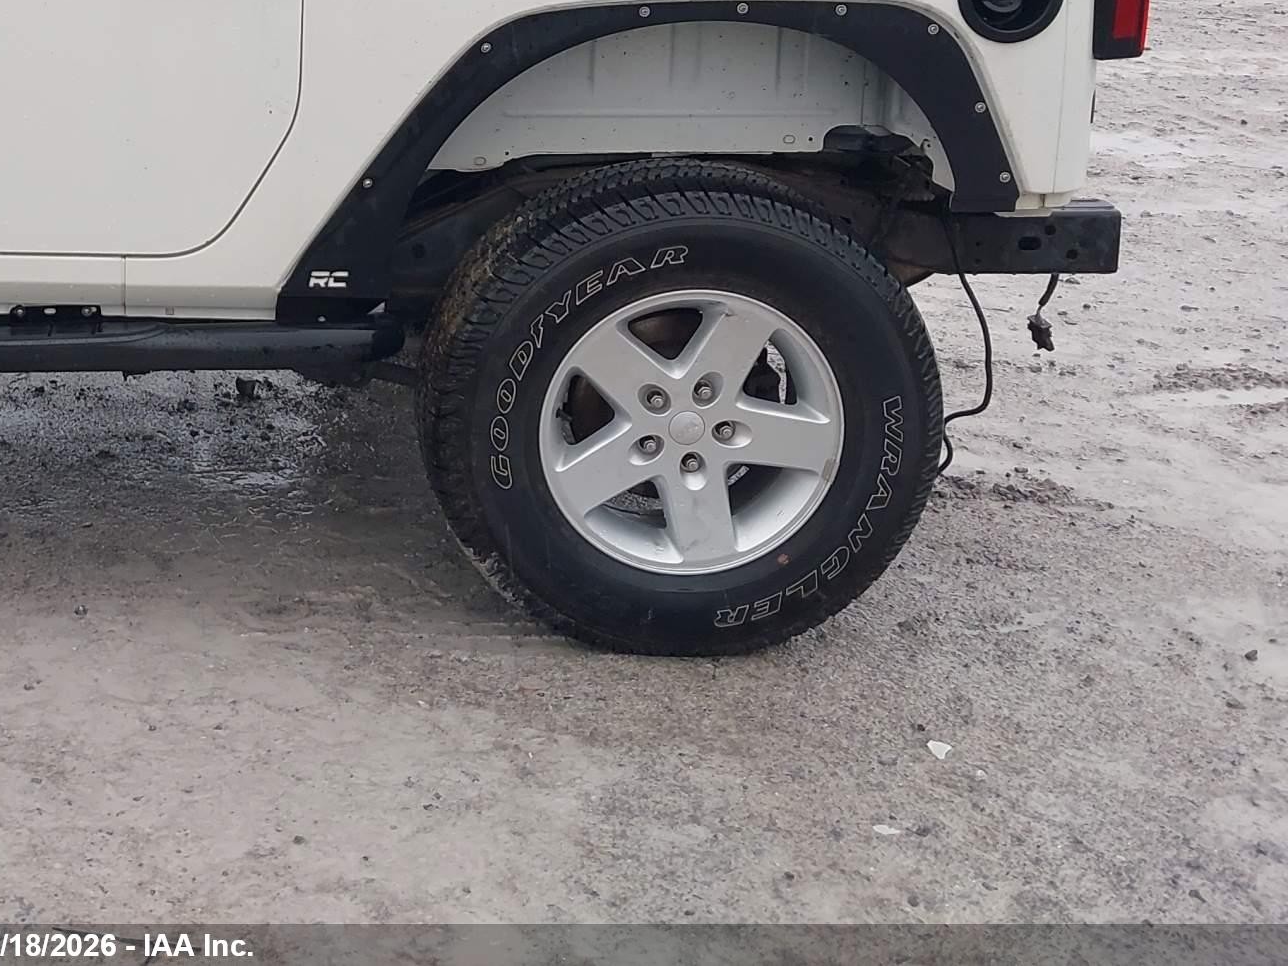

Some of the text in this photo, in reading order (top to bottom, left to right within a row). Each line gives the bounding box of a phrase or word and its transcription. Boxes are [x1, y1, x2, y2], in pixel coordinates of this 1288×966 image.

[309, 270, 350, 288] RC
[489, 244, 689, 491] GOODYEAR
[713, 393, 904, 628] WRANGLER
